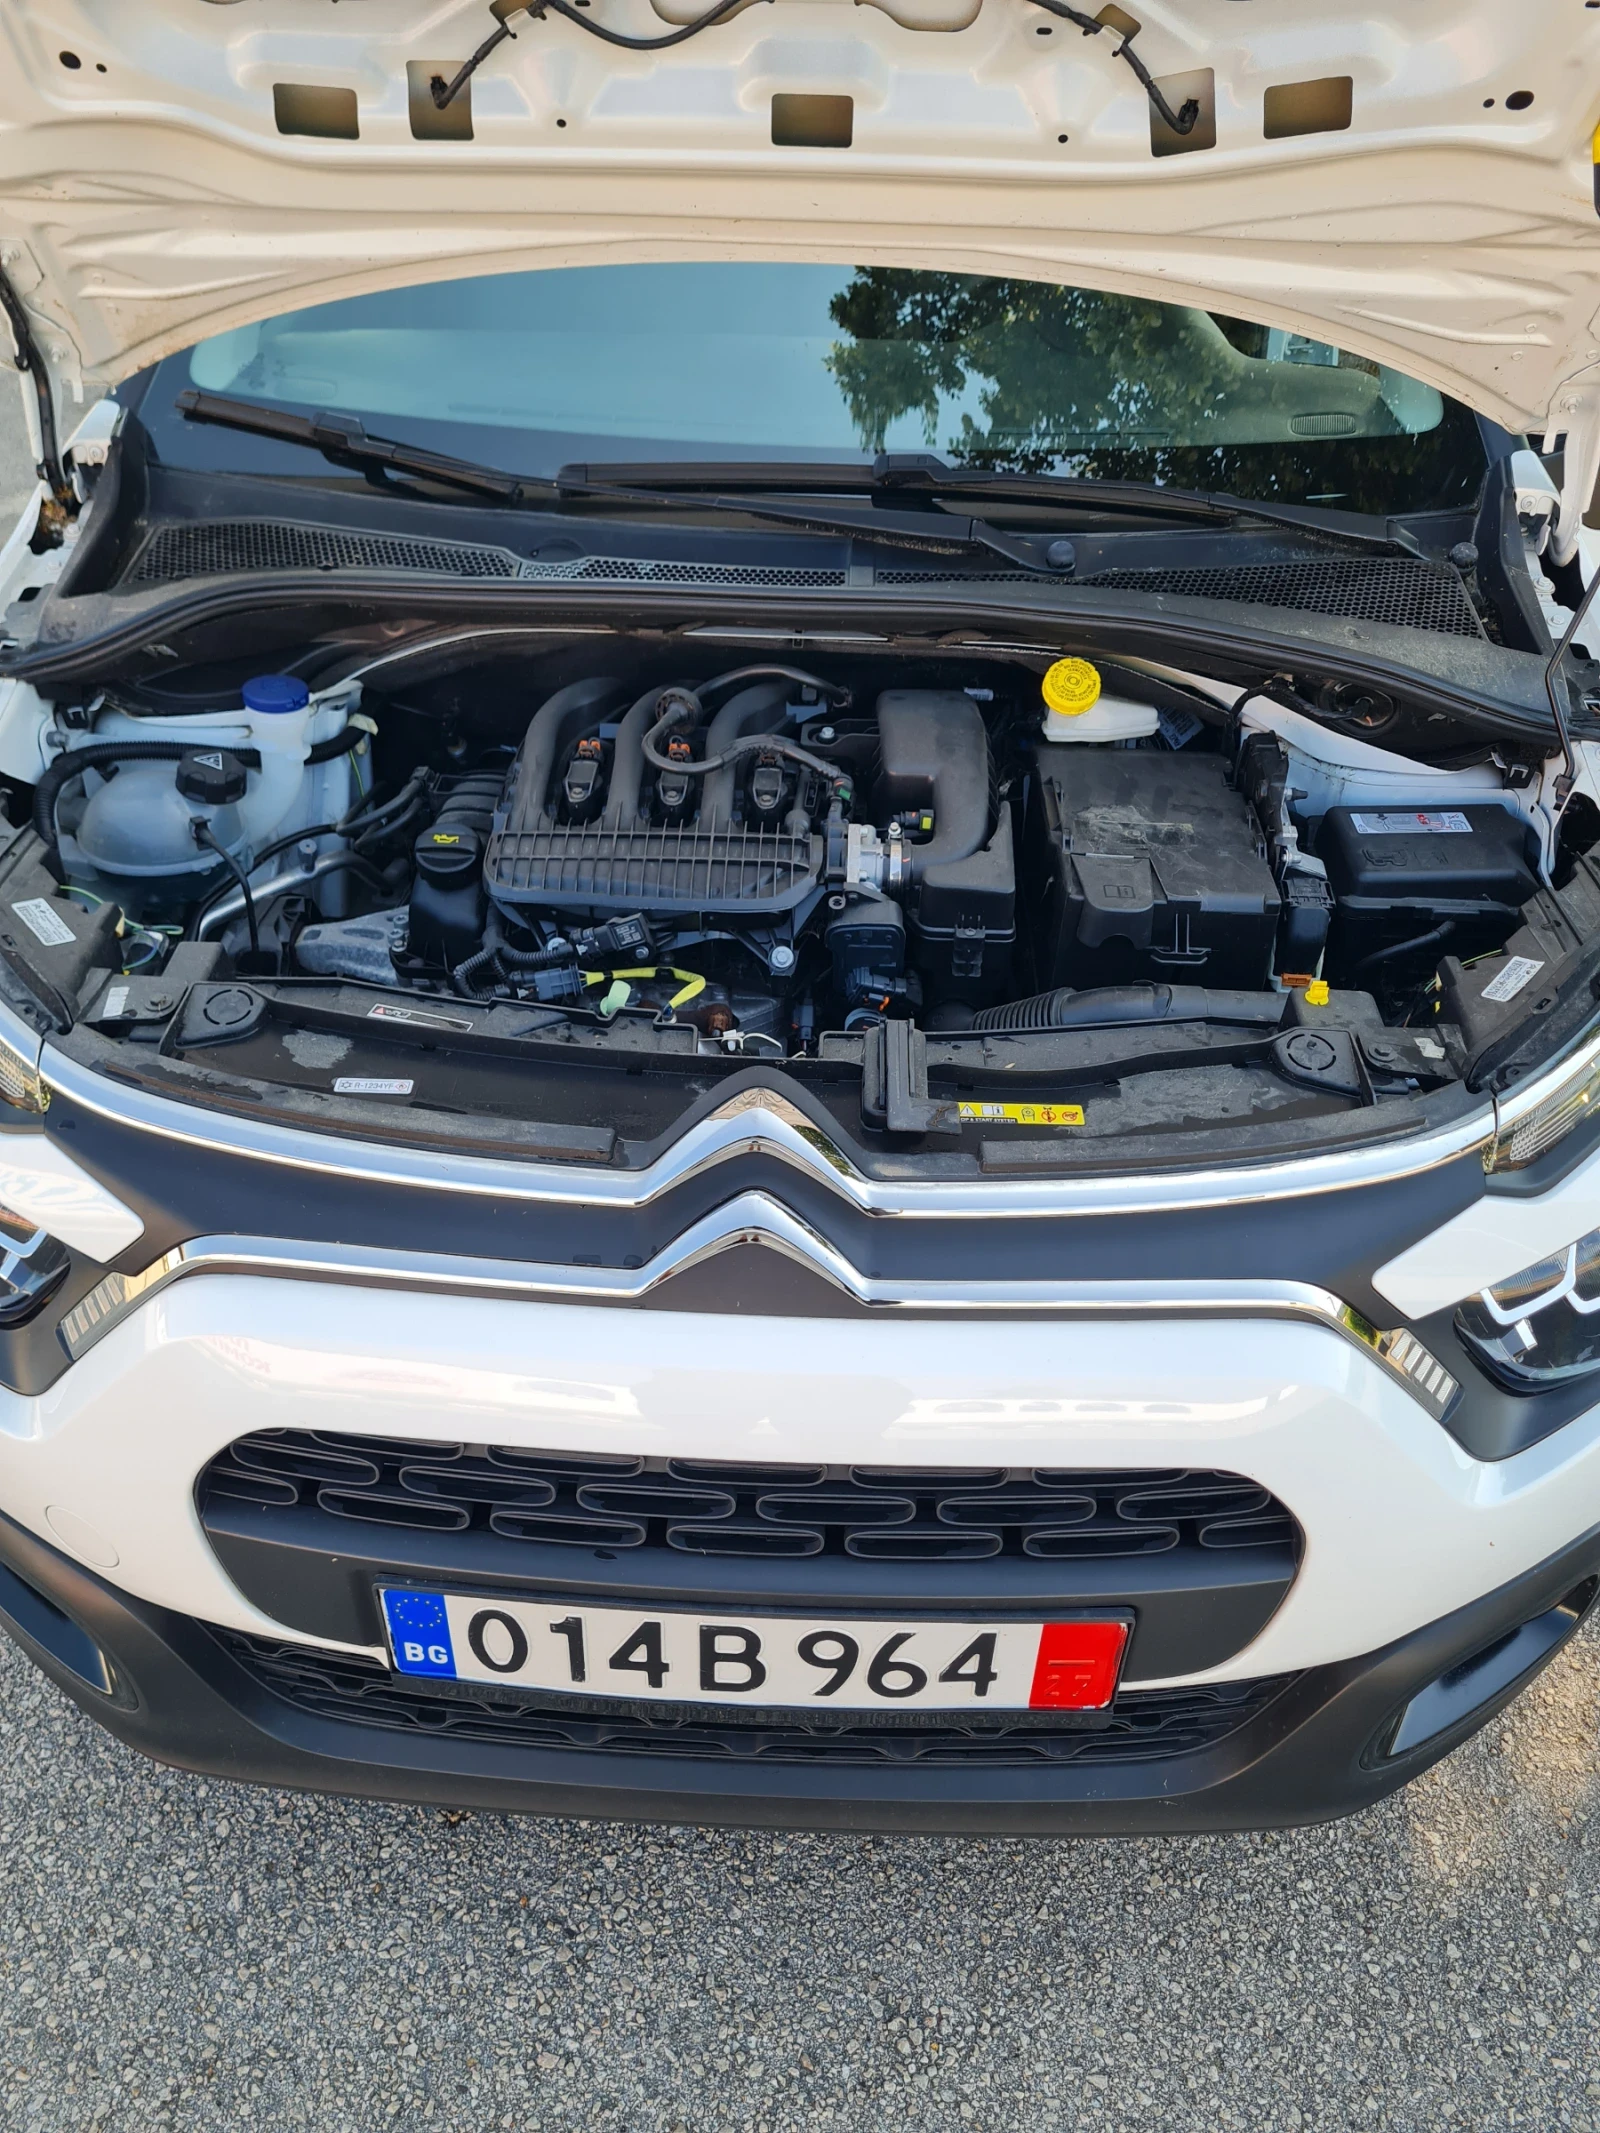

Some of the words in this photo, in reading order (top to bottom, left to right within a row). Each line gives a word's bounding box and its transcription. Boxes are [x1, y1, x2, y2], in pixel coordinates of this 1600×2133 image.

[354, 1082, 395, 1090] R-1234YF
[403, 1641, 449, 1665] BG
[468, 1609, 670, 1688] 014
[700, 1625, 766, 1692] B
[797, 1631, 998, 1698] 964
